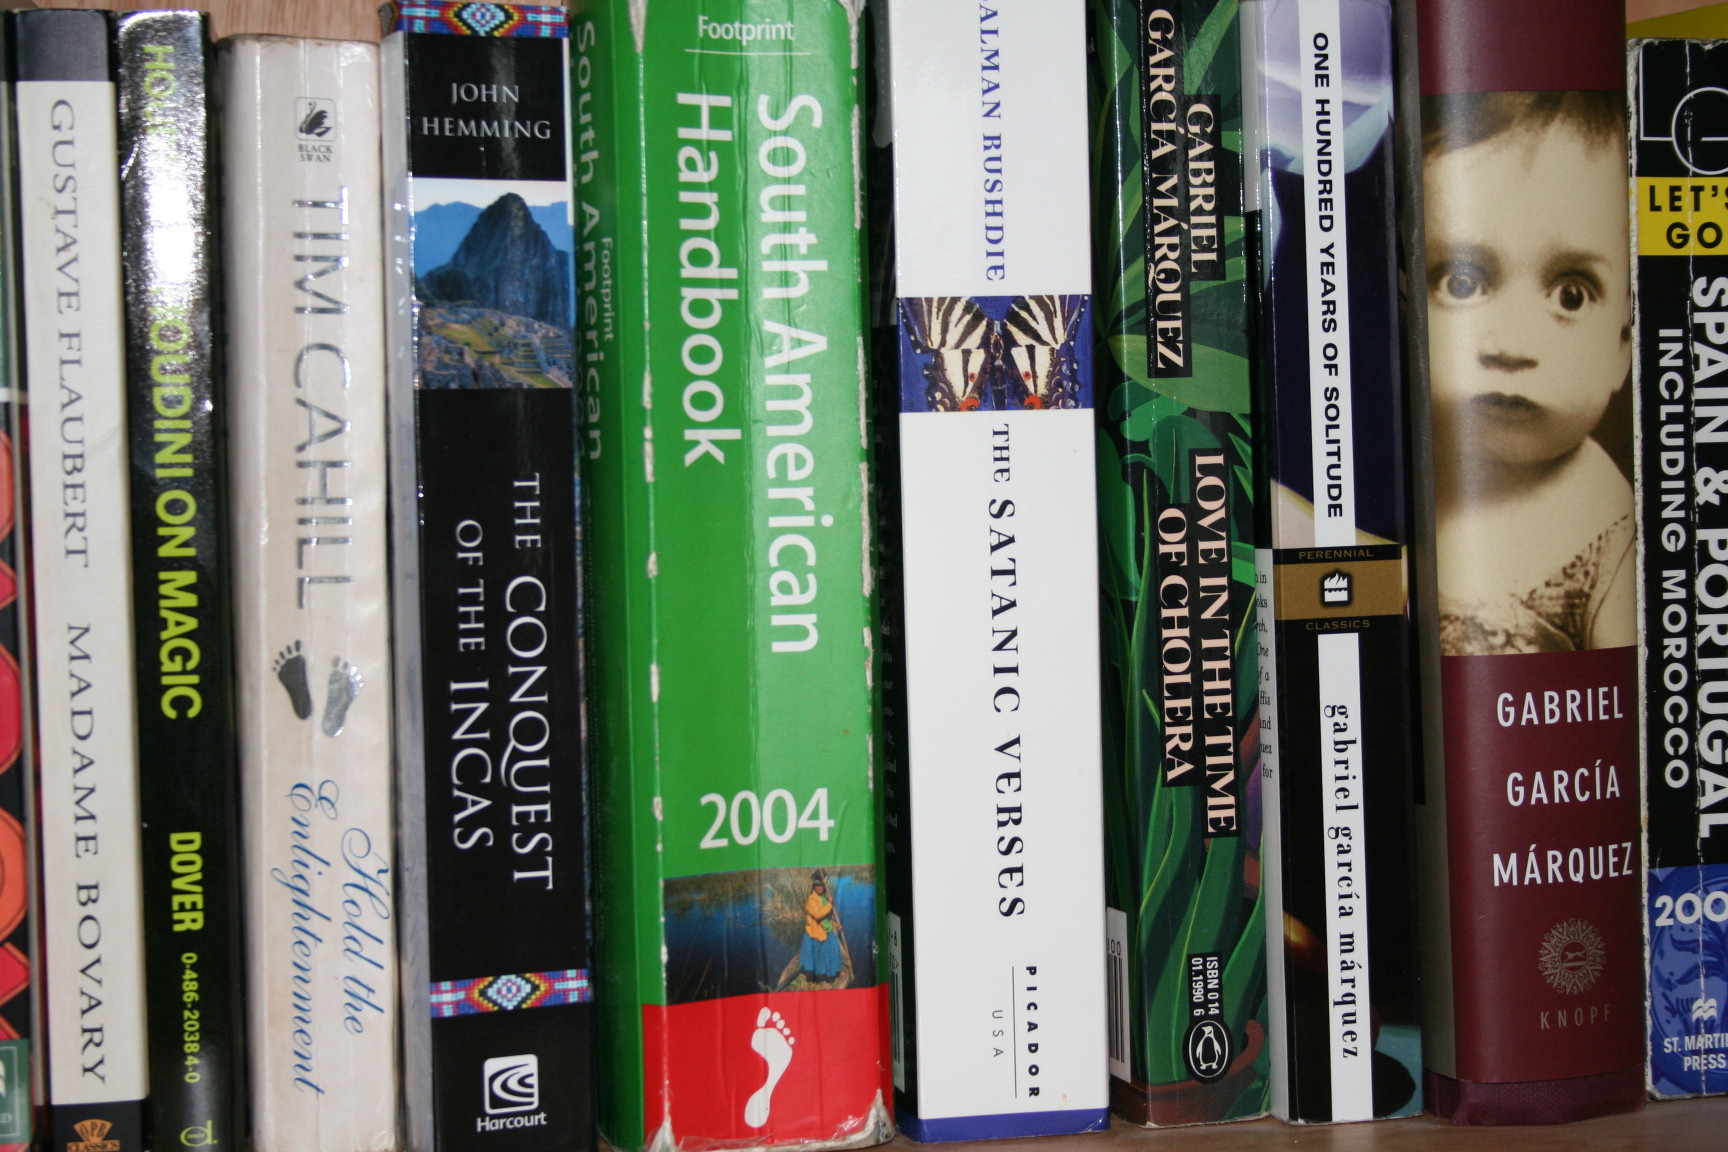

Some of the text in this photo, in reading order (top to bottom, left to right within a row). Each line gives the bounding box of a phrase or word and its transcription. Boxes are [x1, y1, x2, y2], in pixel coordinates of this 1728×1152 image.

[450, 82, 520, 104] JOHN
[698, 15, 795, 46] Footprint
[298, 144, 333, 154] BLACK
[300, 153, 332, 163] SWAN
[422, 116, 552, 140] HEMMING
[578, 21, 599, 184] South
[980, 0, 1006, 282] ALMAN RUSHDIE
[1148, 9, 1189, 369] GARCÍA MÁRQUEZ
[1187, 103, 1218, 273] GABRIEL
[1649, 185, 1728, 212] LET'
[1666, 221, 1723, 249] GO
[581, 202, 604, 459] American
[601, 237, 615, 342] Footprint
[676, 93, 742, 467] Handbook
[1313, 32, 1343, 518] ONE HUNDRED YEARS OF SOLITUDE
[291, 185, 354, 609] TIM CAHILL
[758, 94, 834, 653] South American
[155, 491, 198, 558] ON
[1298, 549, 1375, 560] PERENNIAL
[1658, 328, 1690, 789] INCLUDING MOROCCO
[1692, 276, 1728, 838] SPAIN & PORTUGAL
[50, 100, 106, 1085] GUSTAVE FLAUBERT MADAME BOVARY
[158, 571, 202, 720] MAGIC
[1158, 508, 1195, 782] OF CHOLERA
[1195, 453, 1237, 832] LOVE IN THE TIME
[1305, 619, 1371, 631] CLASSICS
[450, 520, 494, 850] OF THE INCAS
[500, 472, 554, 890] THE CONQUEST
[989, 423, 1026, 918] THE SATANIC VERSES
[1497, 686, 1624, 727] GABRIEL
[700, 787, 834, 849] 2004
[1263, 763, 1273, 779] for
[1506, 760, 1620, 807] GARCÍA
[1324, 705, 1362, 1059] gabriel garcía márquez
[1493, 842, 1633, 888] MÁRQUEZ
[169, 832, 204, 1083] DOVER 0-486-20384-0
[271, 779, 340, 1099] Enlightenment
[342, 827, 390, 1035] Hold the
[1191, 957, 1205, 1017] 01.1990 6
[1206, 957, 1220, 1015] ISBN 0 14
[1026, 966, 1040, 1097] PICADOR
[1540, 1003, 1610, 1030] KNOPF
[1663, 1037, 1681, 1053] ST.
[1683, 1053, 1726, 1071] PRESS
[476, 1111, 547, 1132] Harcourt
